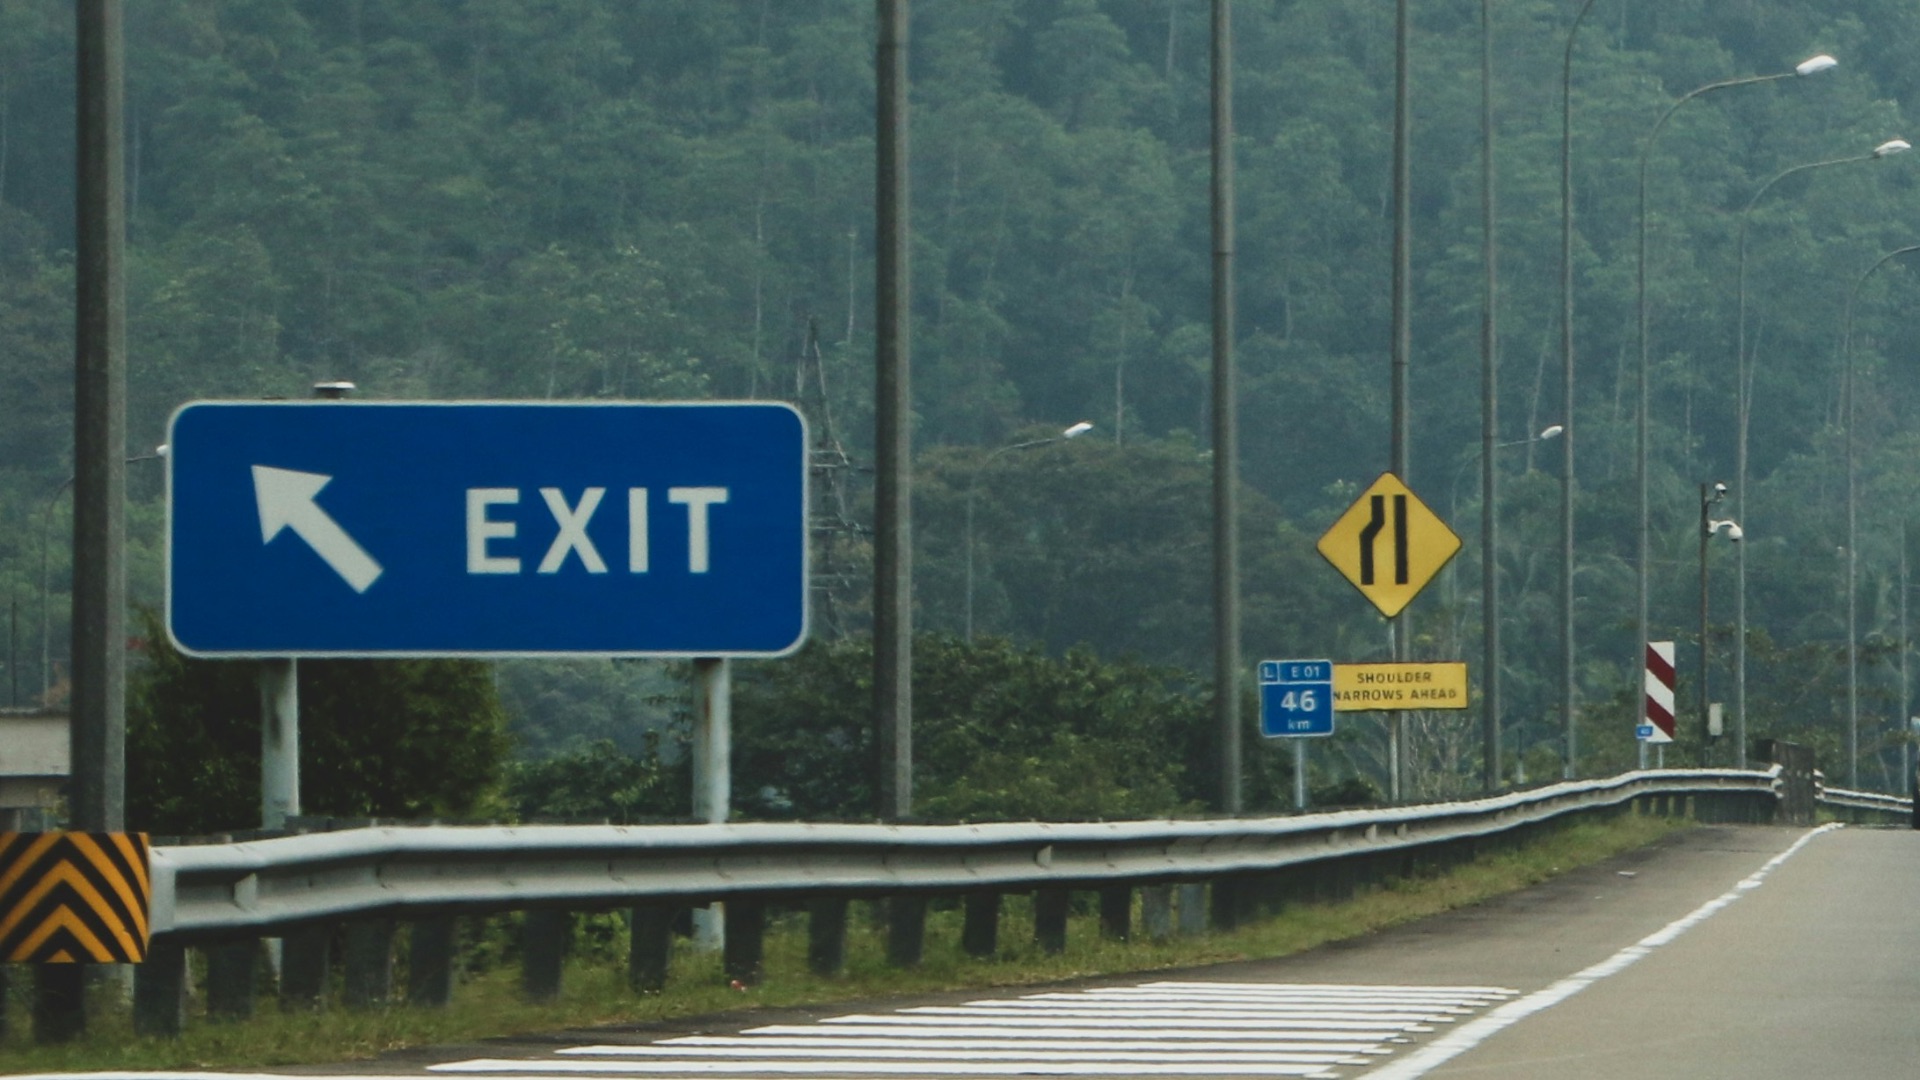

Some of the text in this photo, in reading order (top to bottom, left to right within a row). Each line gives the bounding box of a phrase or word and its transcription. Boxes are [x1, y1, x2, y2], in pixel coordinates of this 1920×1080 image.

[465, 486, 730, 575] EXIT
[1264, 666, 1274, 679] L
[1291, 665, 1321, 677] E 01
[1357, 672, 1432, 683] SHOULDER
[1281, 690, 1317, 712] 46
[1333, 688, 1457, 701] NARROWS AHEAD
[1288, 718, 1310, 729] km
